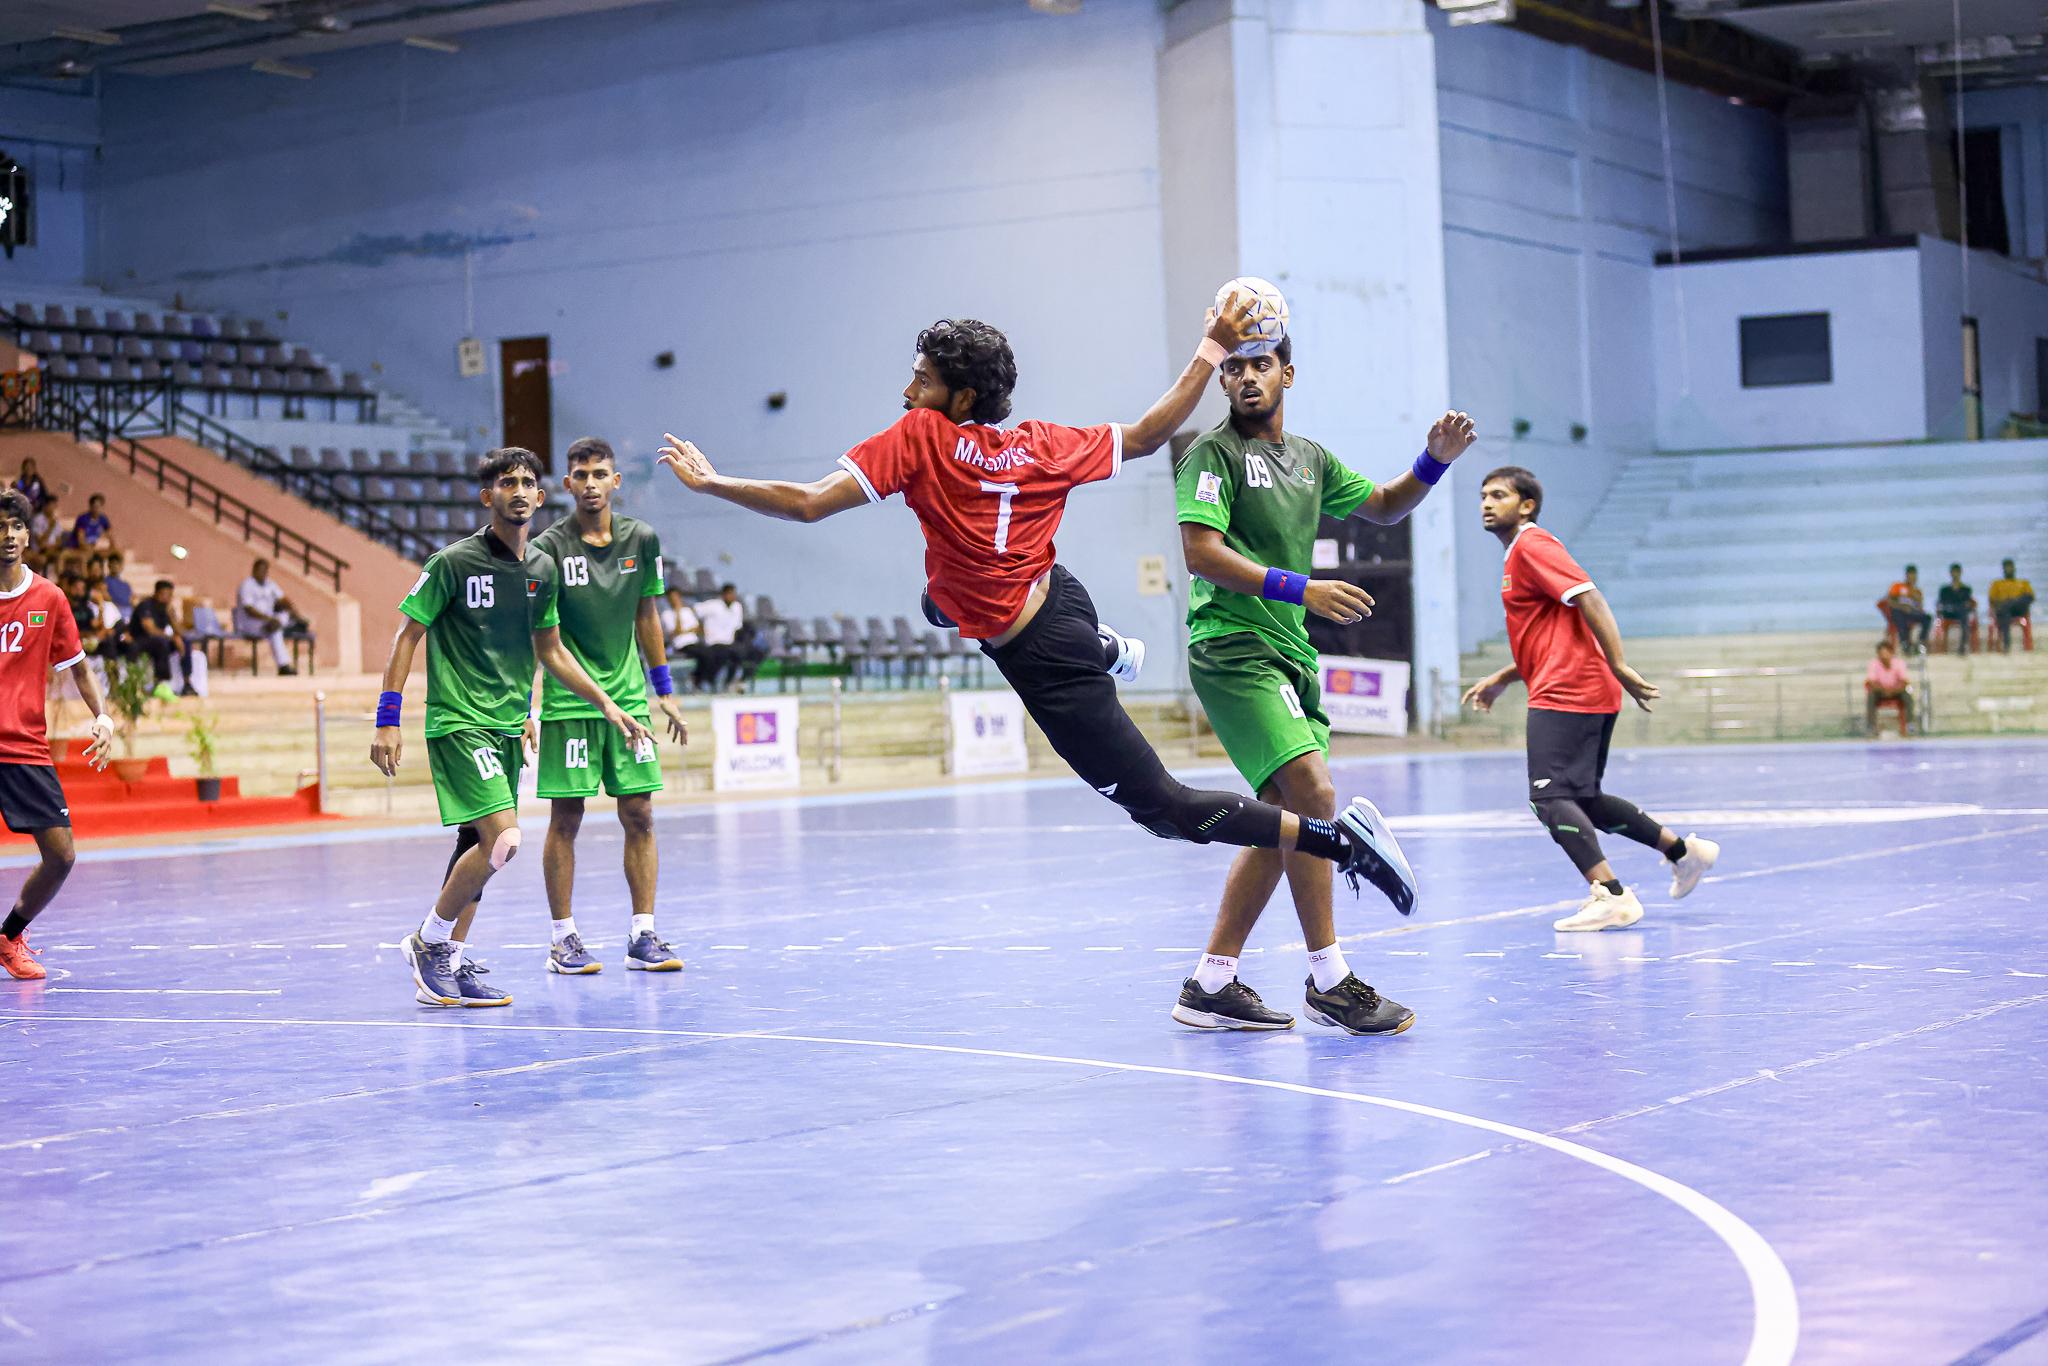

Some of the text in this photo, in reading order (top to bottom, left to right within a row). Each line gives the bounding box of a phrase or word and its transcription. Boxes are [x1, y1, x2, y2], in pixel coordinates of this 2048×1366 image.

[1245, 452, 1274, 489] 09
[978, 479, 1021, 555] 7
[563, 555, 590, 588] 03
[466, 574, 495, 609] 05
[0, 621, 24, 653] 12
[1279, 684, 1306, 720] 0
[473, 747, 504, 781] 05
[565, 738, 589, 769] 03
[1207, 957, 1233, 967] RSL
